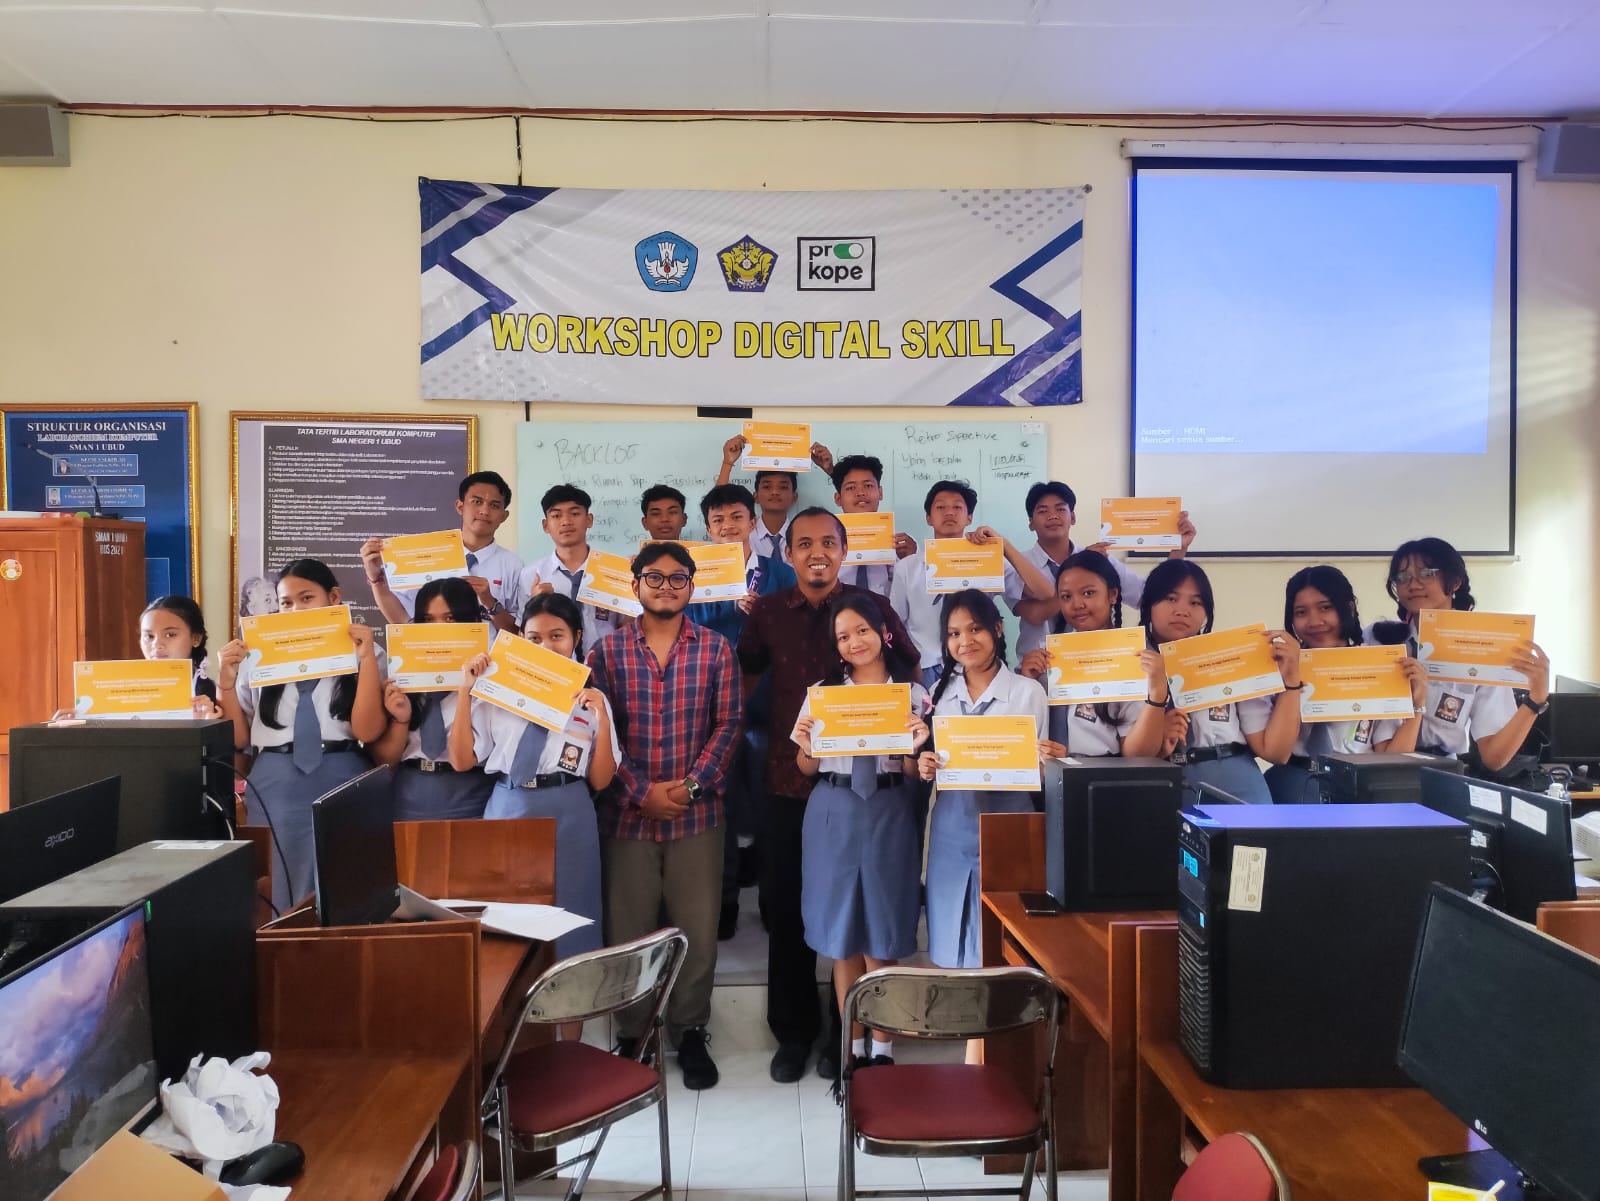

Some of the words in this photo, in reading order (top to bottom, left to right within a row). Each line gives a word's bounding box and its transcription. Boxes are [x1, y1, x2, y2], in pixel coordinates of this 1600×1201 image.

[808, 262, 864, 284] kope
[490, 312, 723, 358] WORKSHOP
[734, 320, 891, 359] DIGITAL
[901, 318, 1015, 359] SKILL
[27, 422, 91, 432] STRUKTUR
[93, 421, 167, 431] ORGANISASI
[315, 428, 339, 436] TERTIB
[340, 429, 396, 437] LABORATORIUM
[396, 430, 437, 438] KOMPUTER
[69, 443, 94, 451] SMAN
[101, 443, 126, 451] UBUD
[380, 438, 402, 446] UBUD
